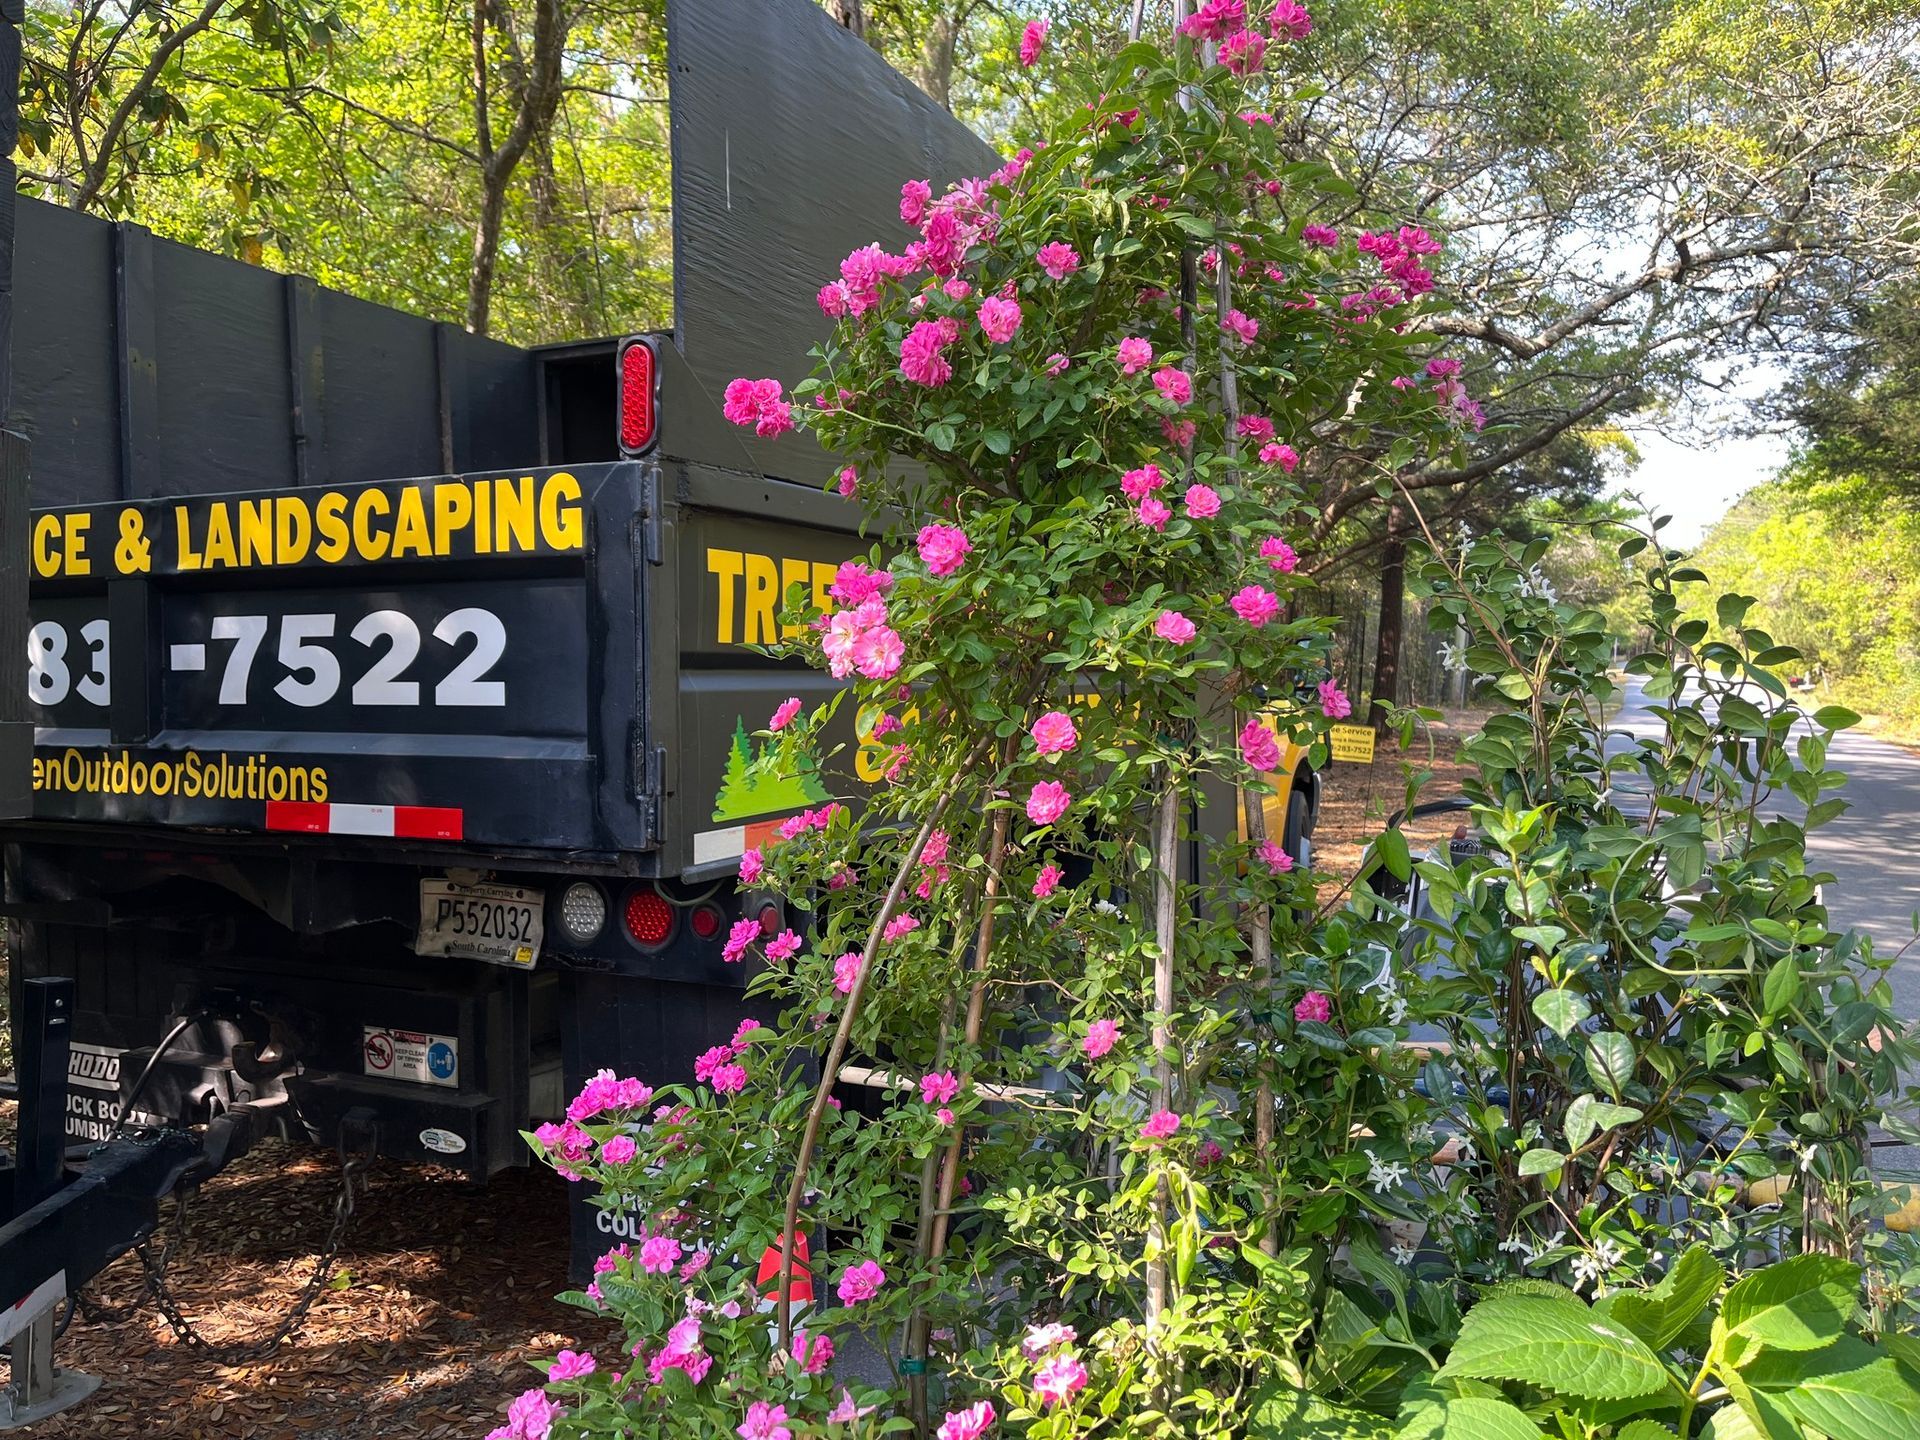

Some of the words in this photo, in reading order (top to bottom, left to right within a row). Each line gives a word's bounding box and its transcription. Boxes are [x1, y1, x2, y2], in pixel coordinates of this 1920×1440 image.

[29, 513, 91, 577] CE
[114, 508, 151, 575] &
[175, 472, 583, 571] LANDSCAPING
[1342, 726, 1372, 737] Service
[436, 898, 533, 943] P552032
[452, 940, 475, 953] South
